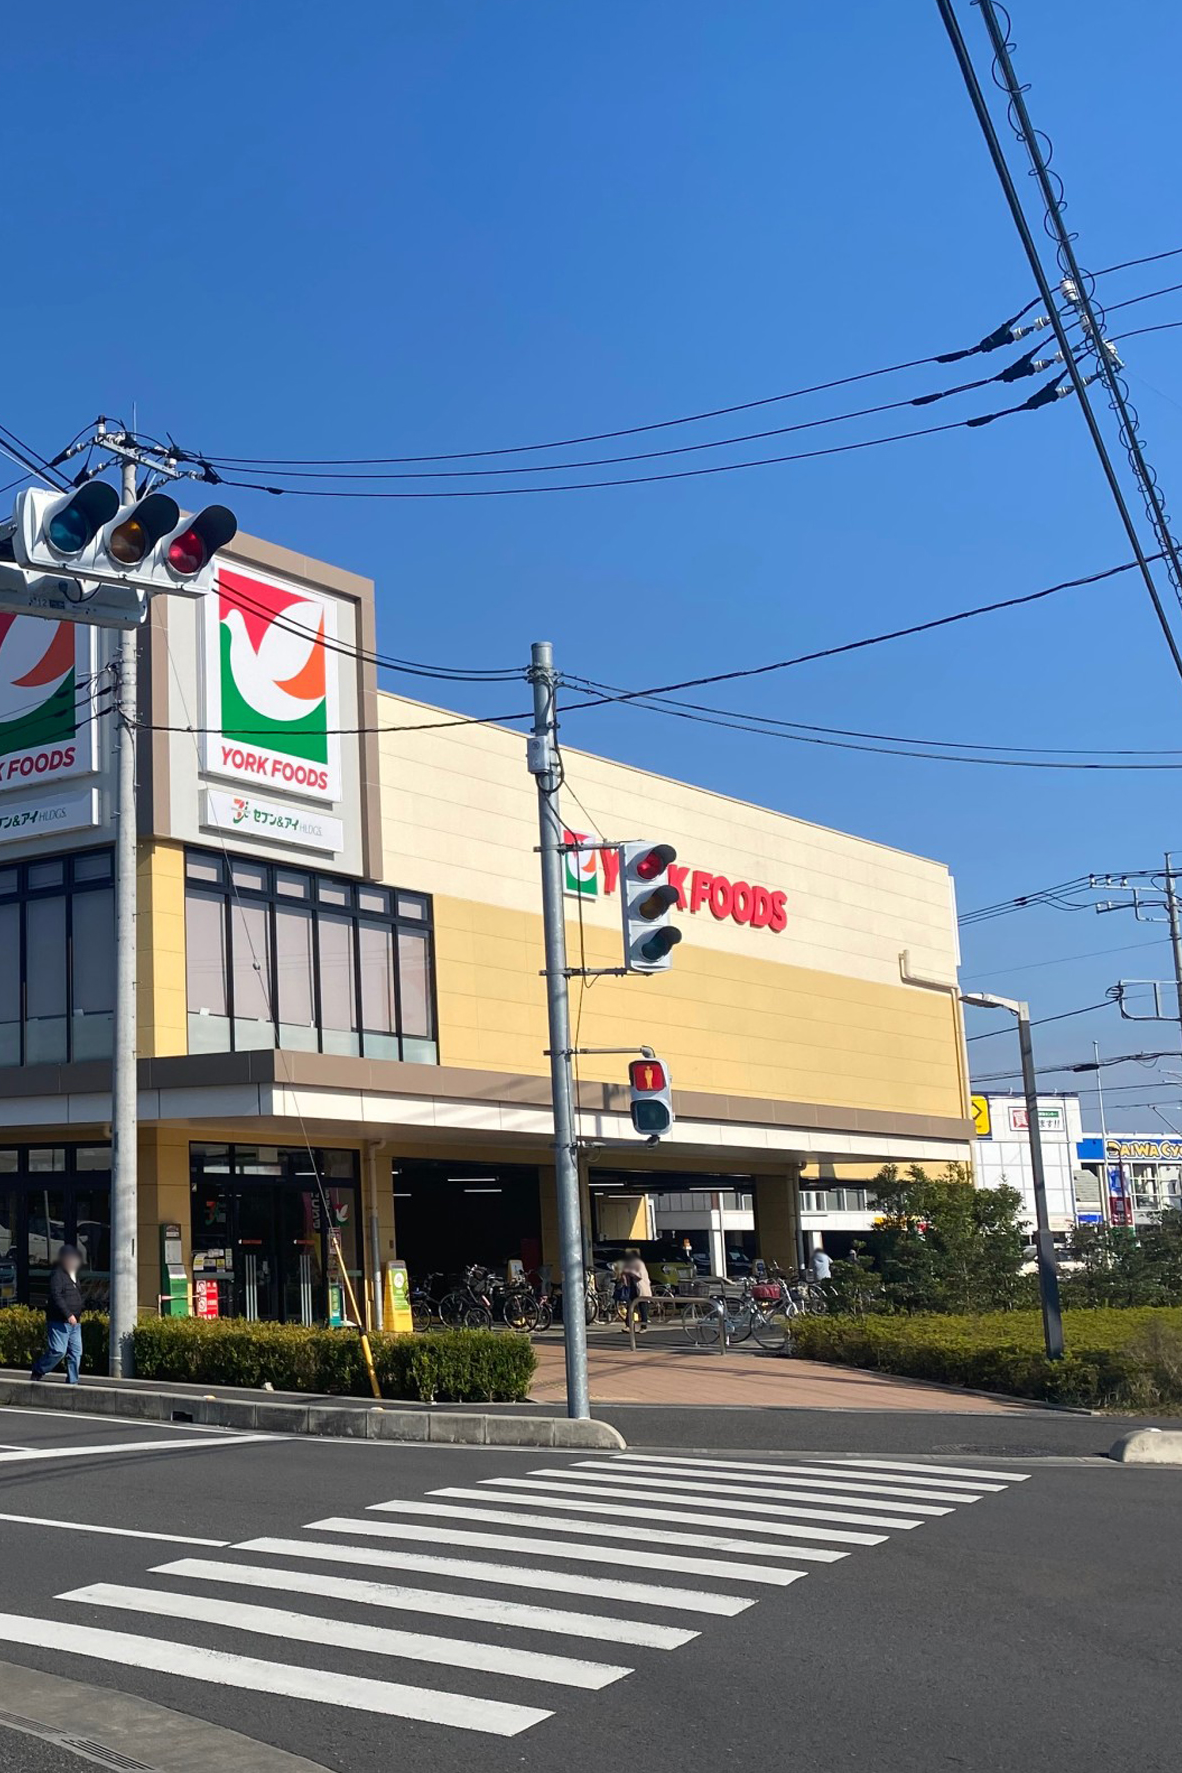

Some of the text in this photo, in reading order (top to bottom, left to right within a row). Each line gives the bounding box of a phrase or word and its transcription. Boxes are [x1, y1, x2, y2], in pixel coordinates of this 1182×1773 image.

[7, 747, 76, 780] FOODS
[221, 745, 328, 790] YORK FOODS
[600, 848, 788, 933] YK FOODS
[1107, 1139, 1160, 1159] DAIWA
